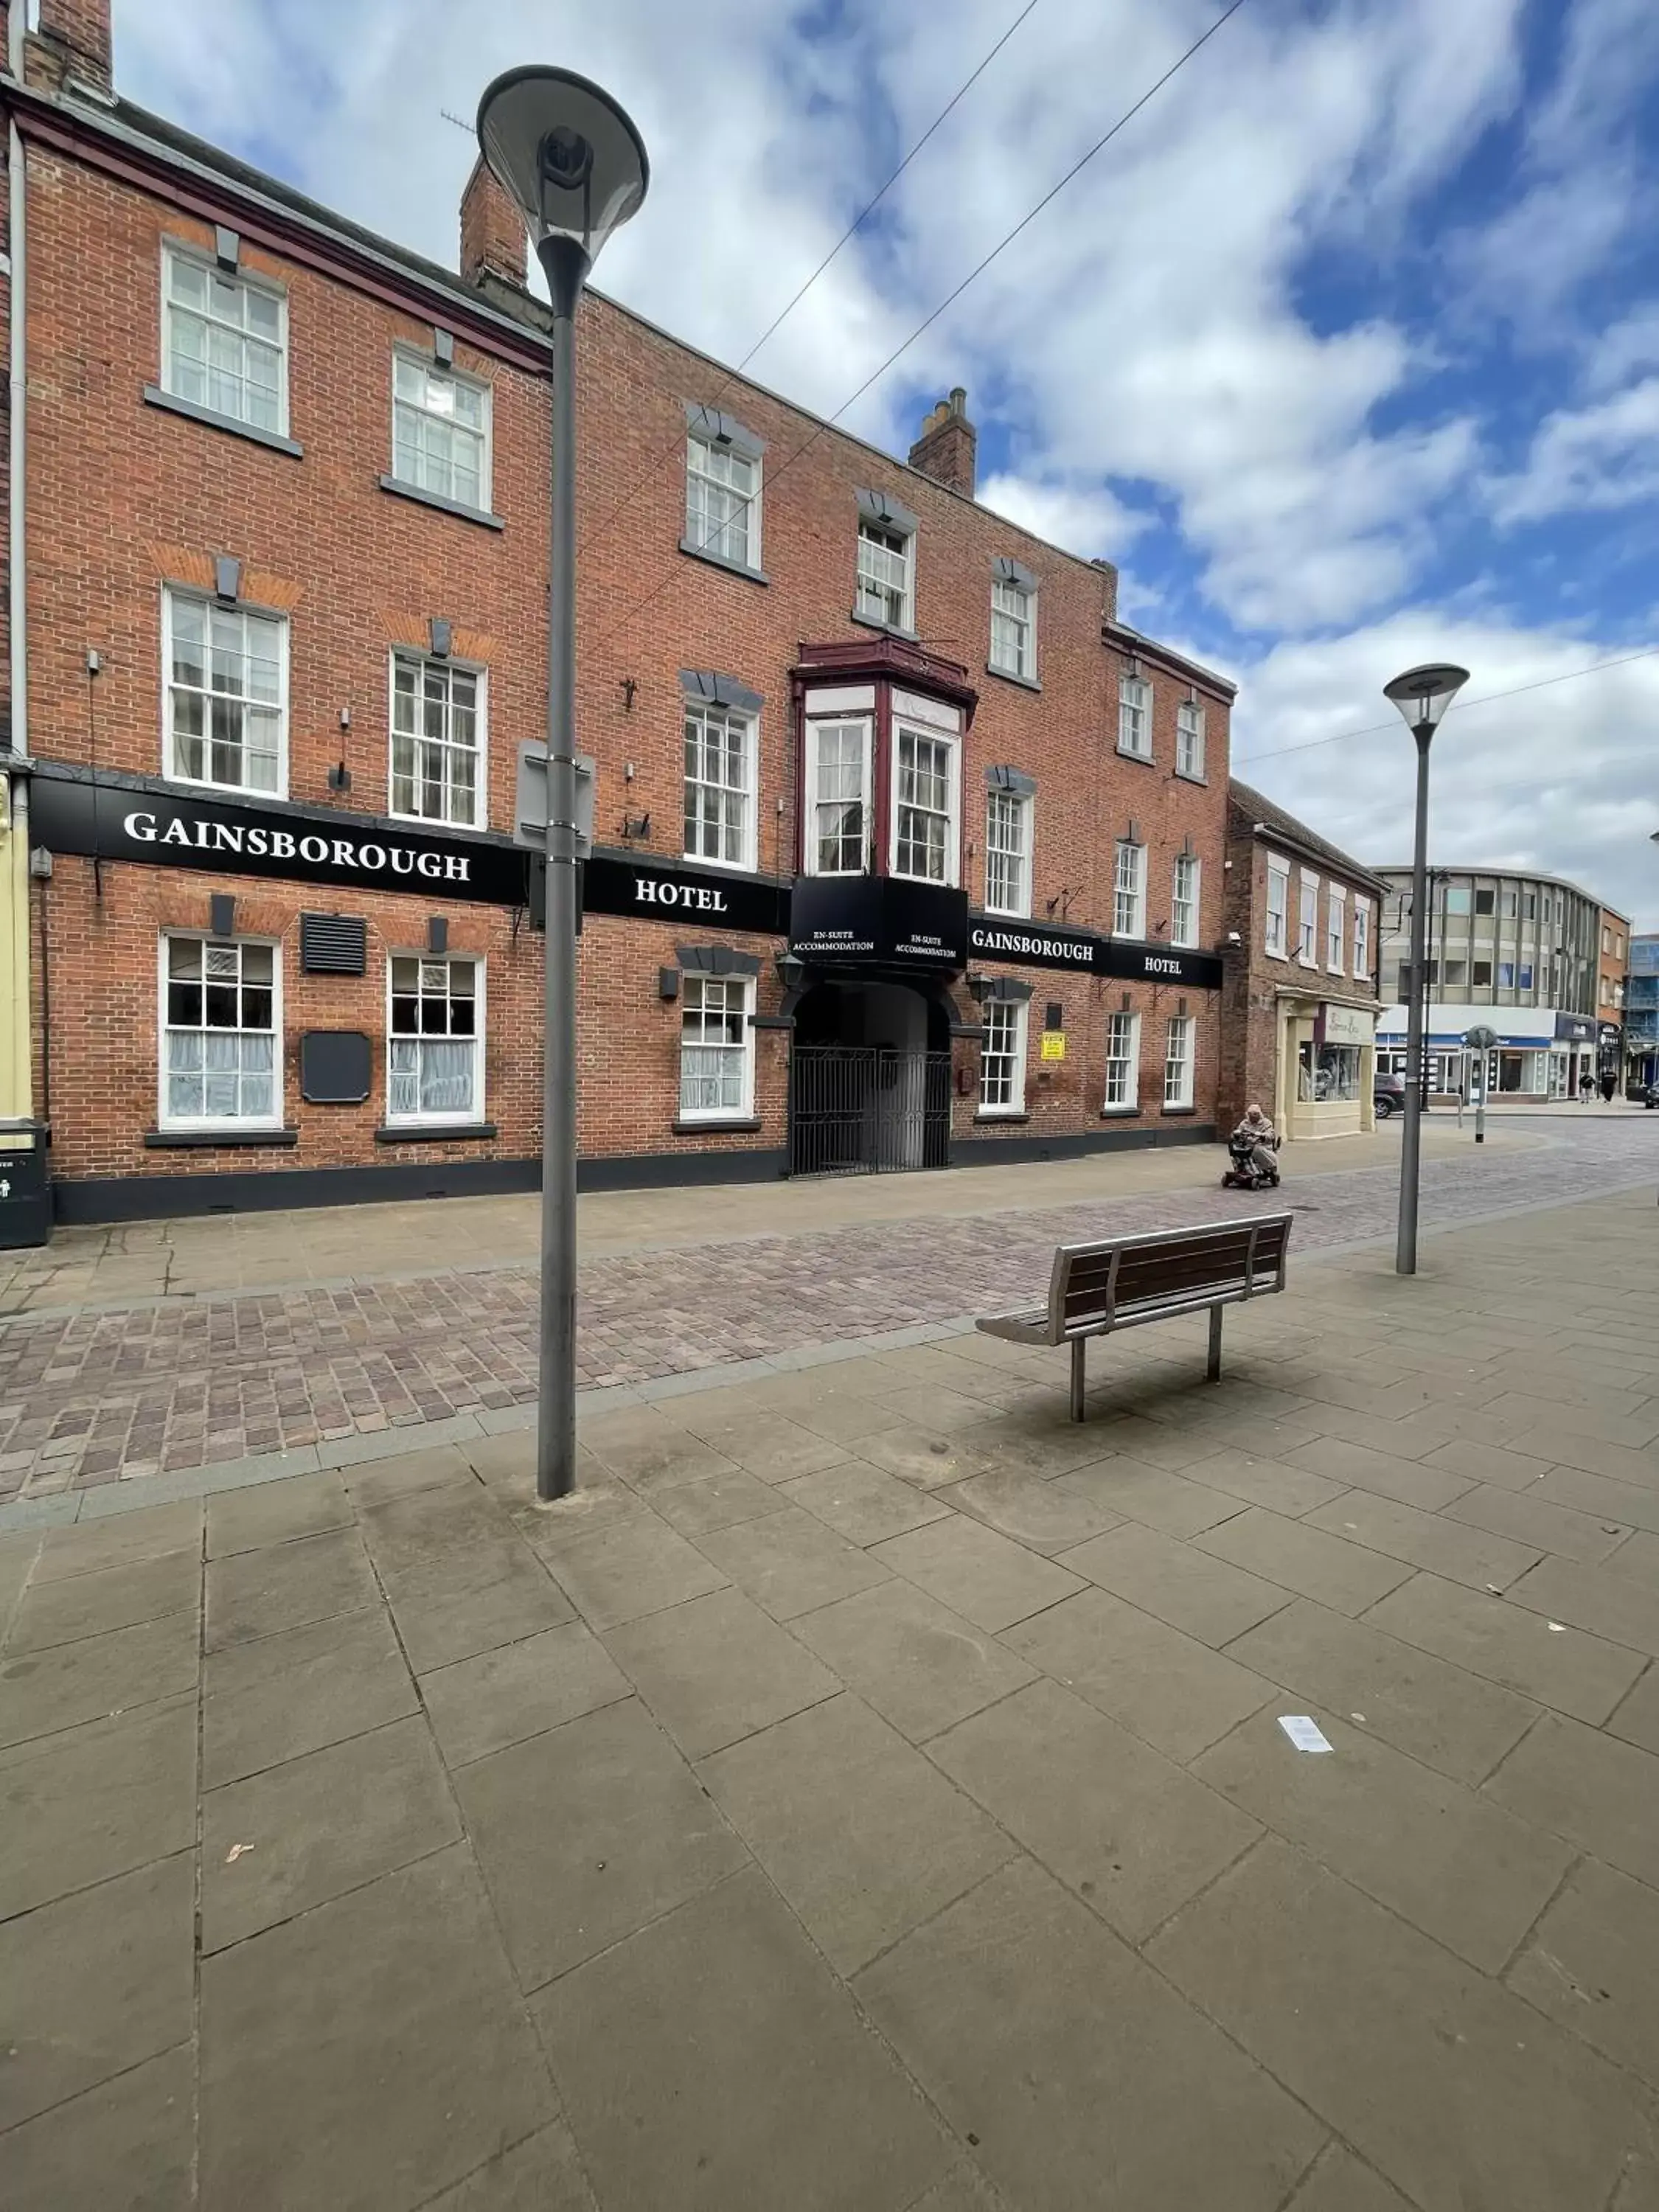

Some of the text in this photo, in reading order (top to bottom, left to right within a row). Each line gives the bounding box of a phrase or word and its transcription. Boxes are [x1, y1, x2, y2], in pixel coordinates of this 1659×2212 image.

[123, 812, 470, 882] GAINSBOROUGH
[635, 879, 728, 912] HOTEL
[813, 931, 854, 939] EN-SUITE
[910, 934, 942, 946] EN-SUITE
[793, 942, 874, 951] ACCOMMODATION
[894, 944, 956, 958] ACCOMMODATION
[971, 929, 1093, 961] GAINSBOROUGH
[1144, 956, 1182, 975] HOTEL
